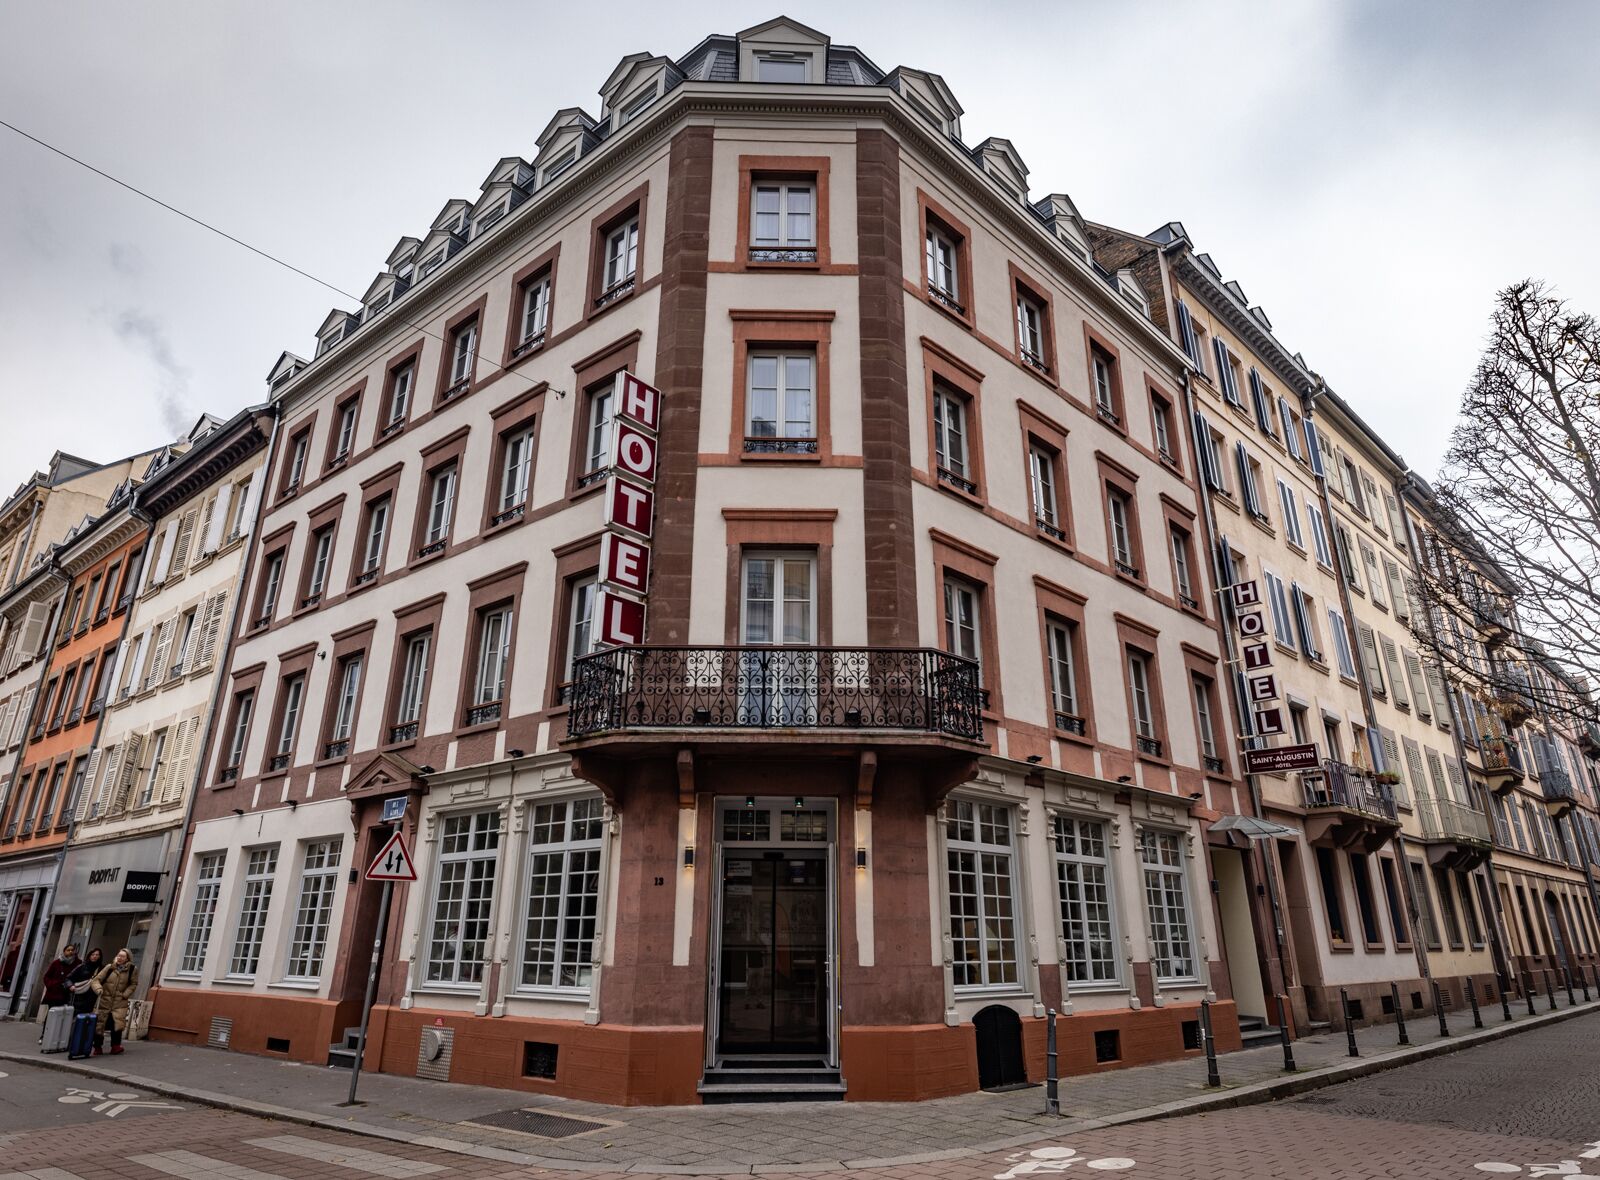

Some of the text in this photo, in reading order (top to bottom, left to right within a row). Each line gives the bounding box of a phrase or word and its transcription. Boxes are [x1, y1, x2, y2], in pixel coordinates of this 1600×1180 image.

[610, 379, 654, 644] HOTEL
[1235, 582, 1278, 733] HOTEL
[1251, 751, 1314, 765] SAINT-AUGUSTIN
[88, 867, 121, 884] BODYHIT
[126, 883, 157, 891] BODYHIT
